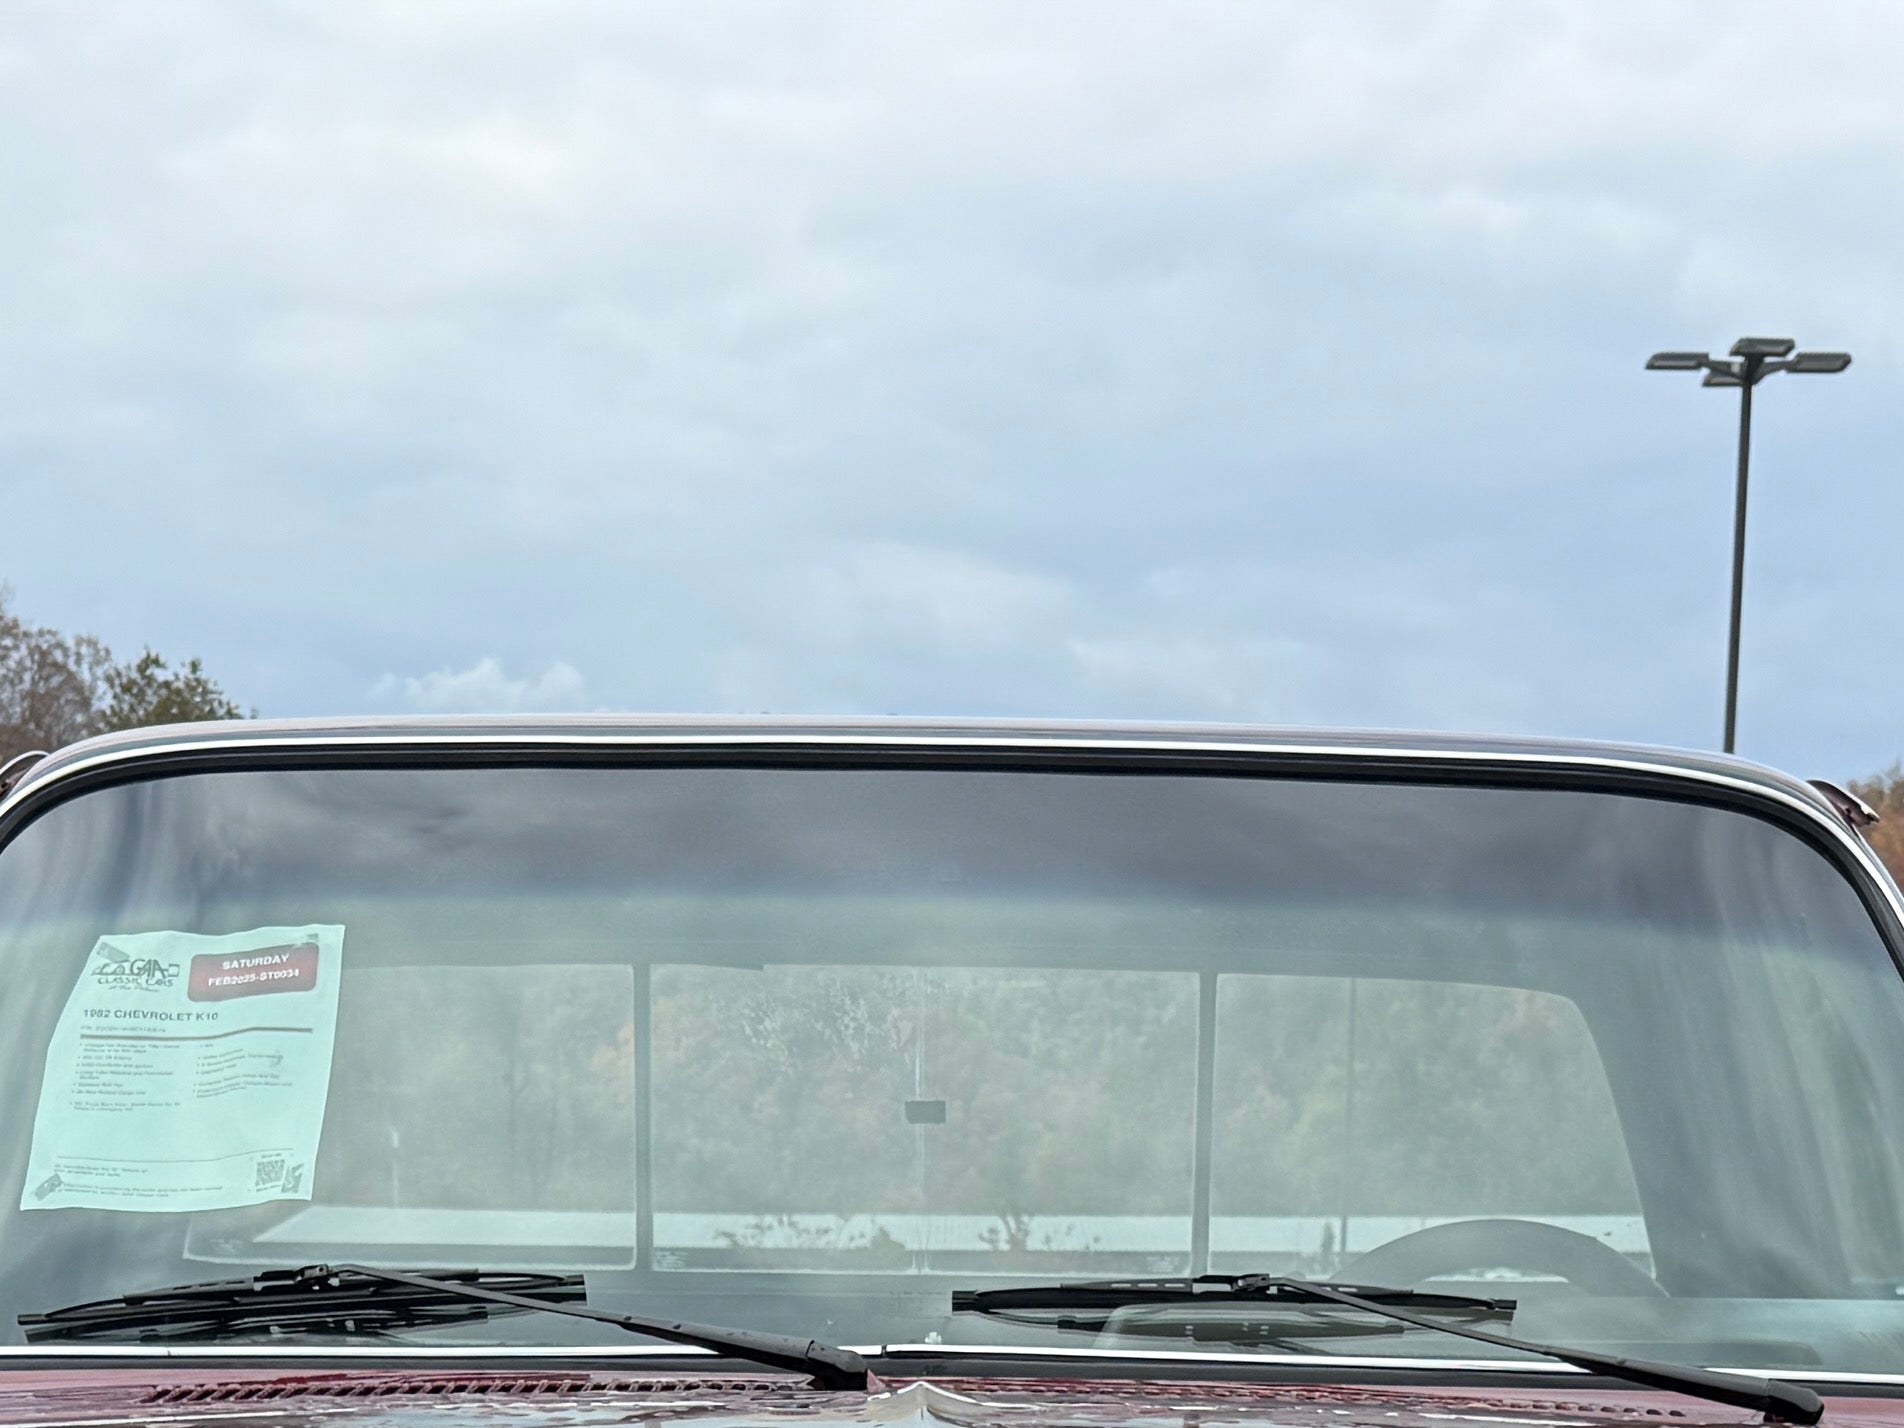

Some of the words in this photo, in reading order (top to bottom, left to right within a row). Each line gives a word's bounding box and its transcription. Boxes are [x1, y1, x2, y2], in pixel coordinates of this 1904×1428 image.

[222, 953, 290, 970] SATURDAY
[97, 976, 141, 986] CLASSIC
[83, 1008, 111, 1019] 1982
[114, 1009, 193, 1022] CHEVROLET
[196, 1011, 219, 1022] K10
